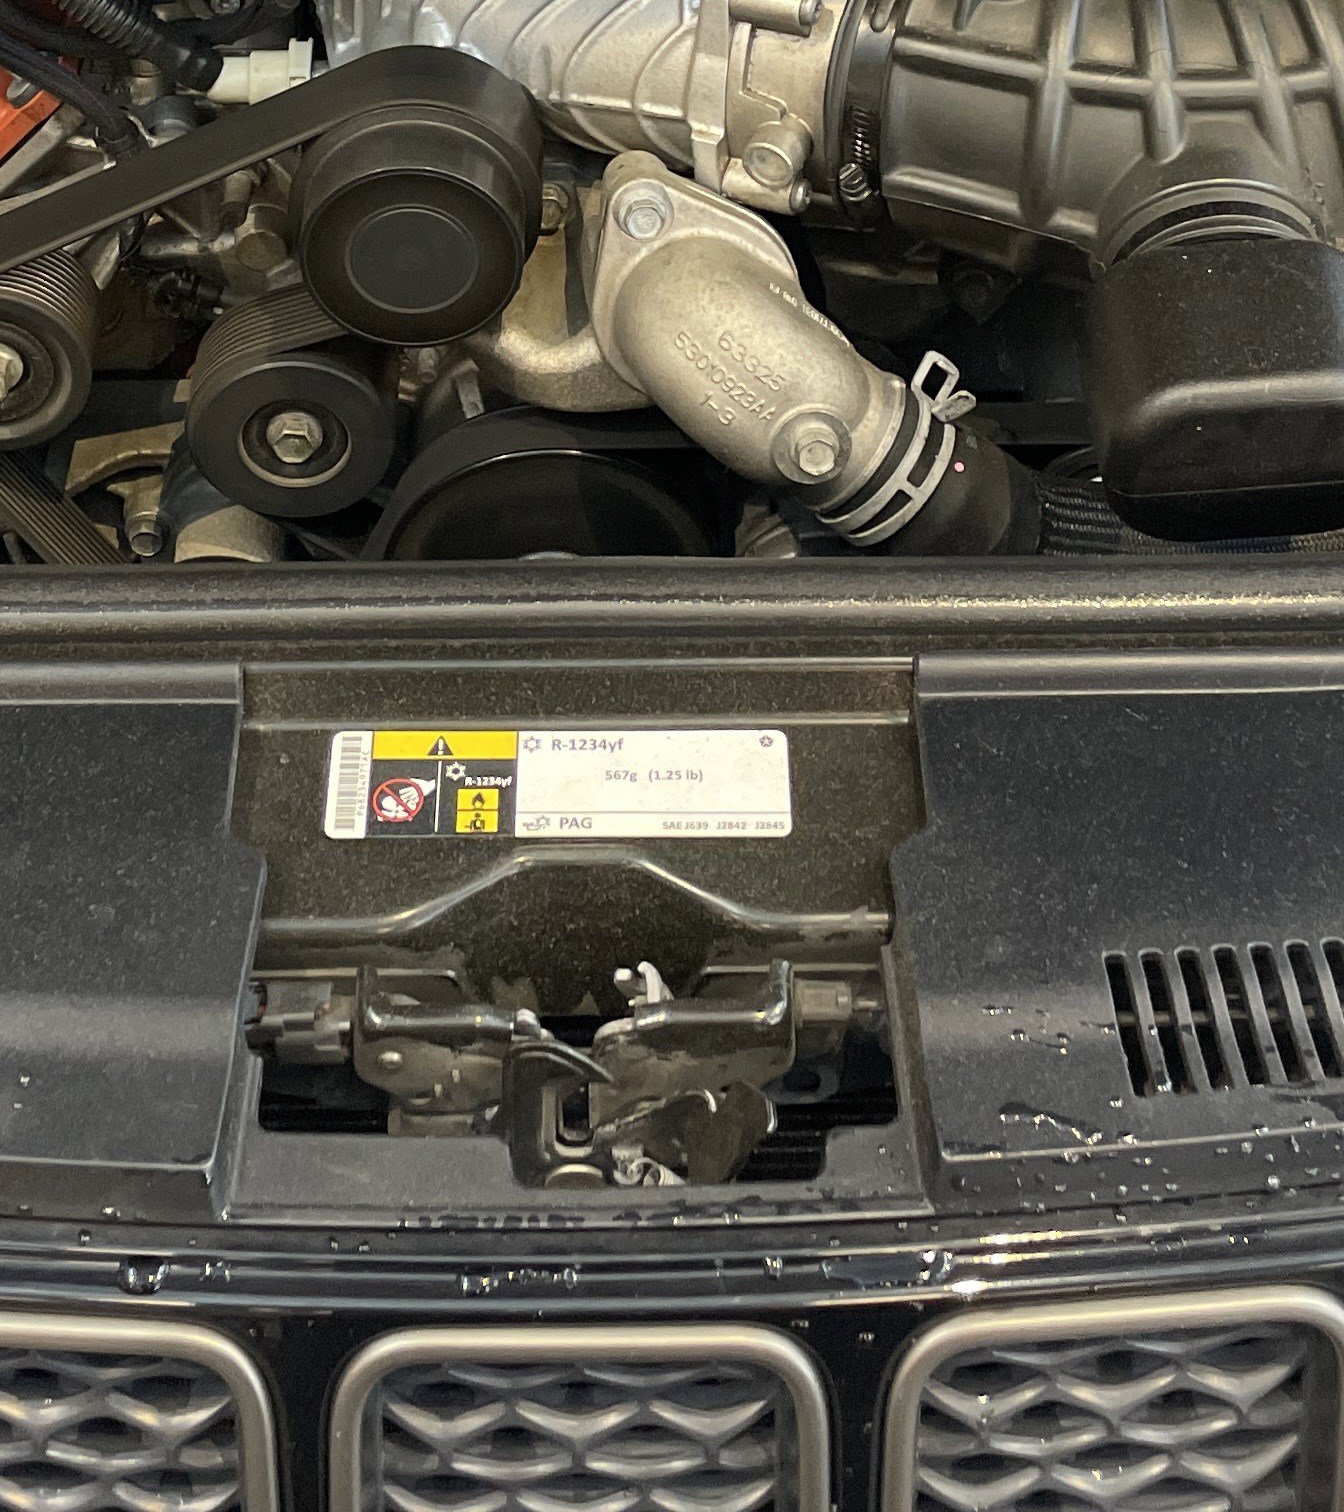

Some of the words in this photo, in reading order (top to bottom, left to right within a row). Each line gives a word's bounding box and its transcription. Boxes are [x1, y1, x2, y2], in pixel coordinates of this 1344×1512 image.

[717, 330, 787, 391] 63325
[551, 737, 625, 753] R-1234yf
[464, 775, 513, 788] R-1234yf
[605, 769, 638, 783] 567g
[648, 769, 682, 783] (1.25
[686, 769, 704, 783] lb)
[559, 816, 593, 830] PAG
[662, 821, 683, 830] SAE
